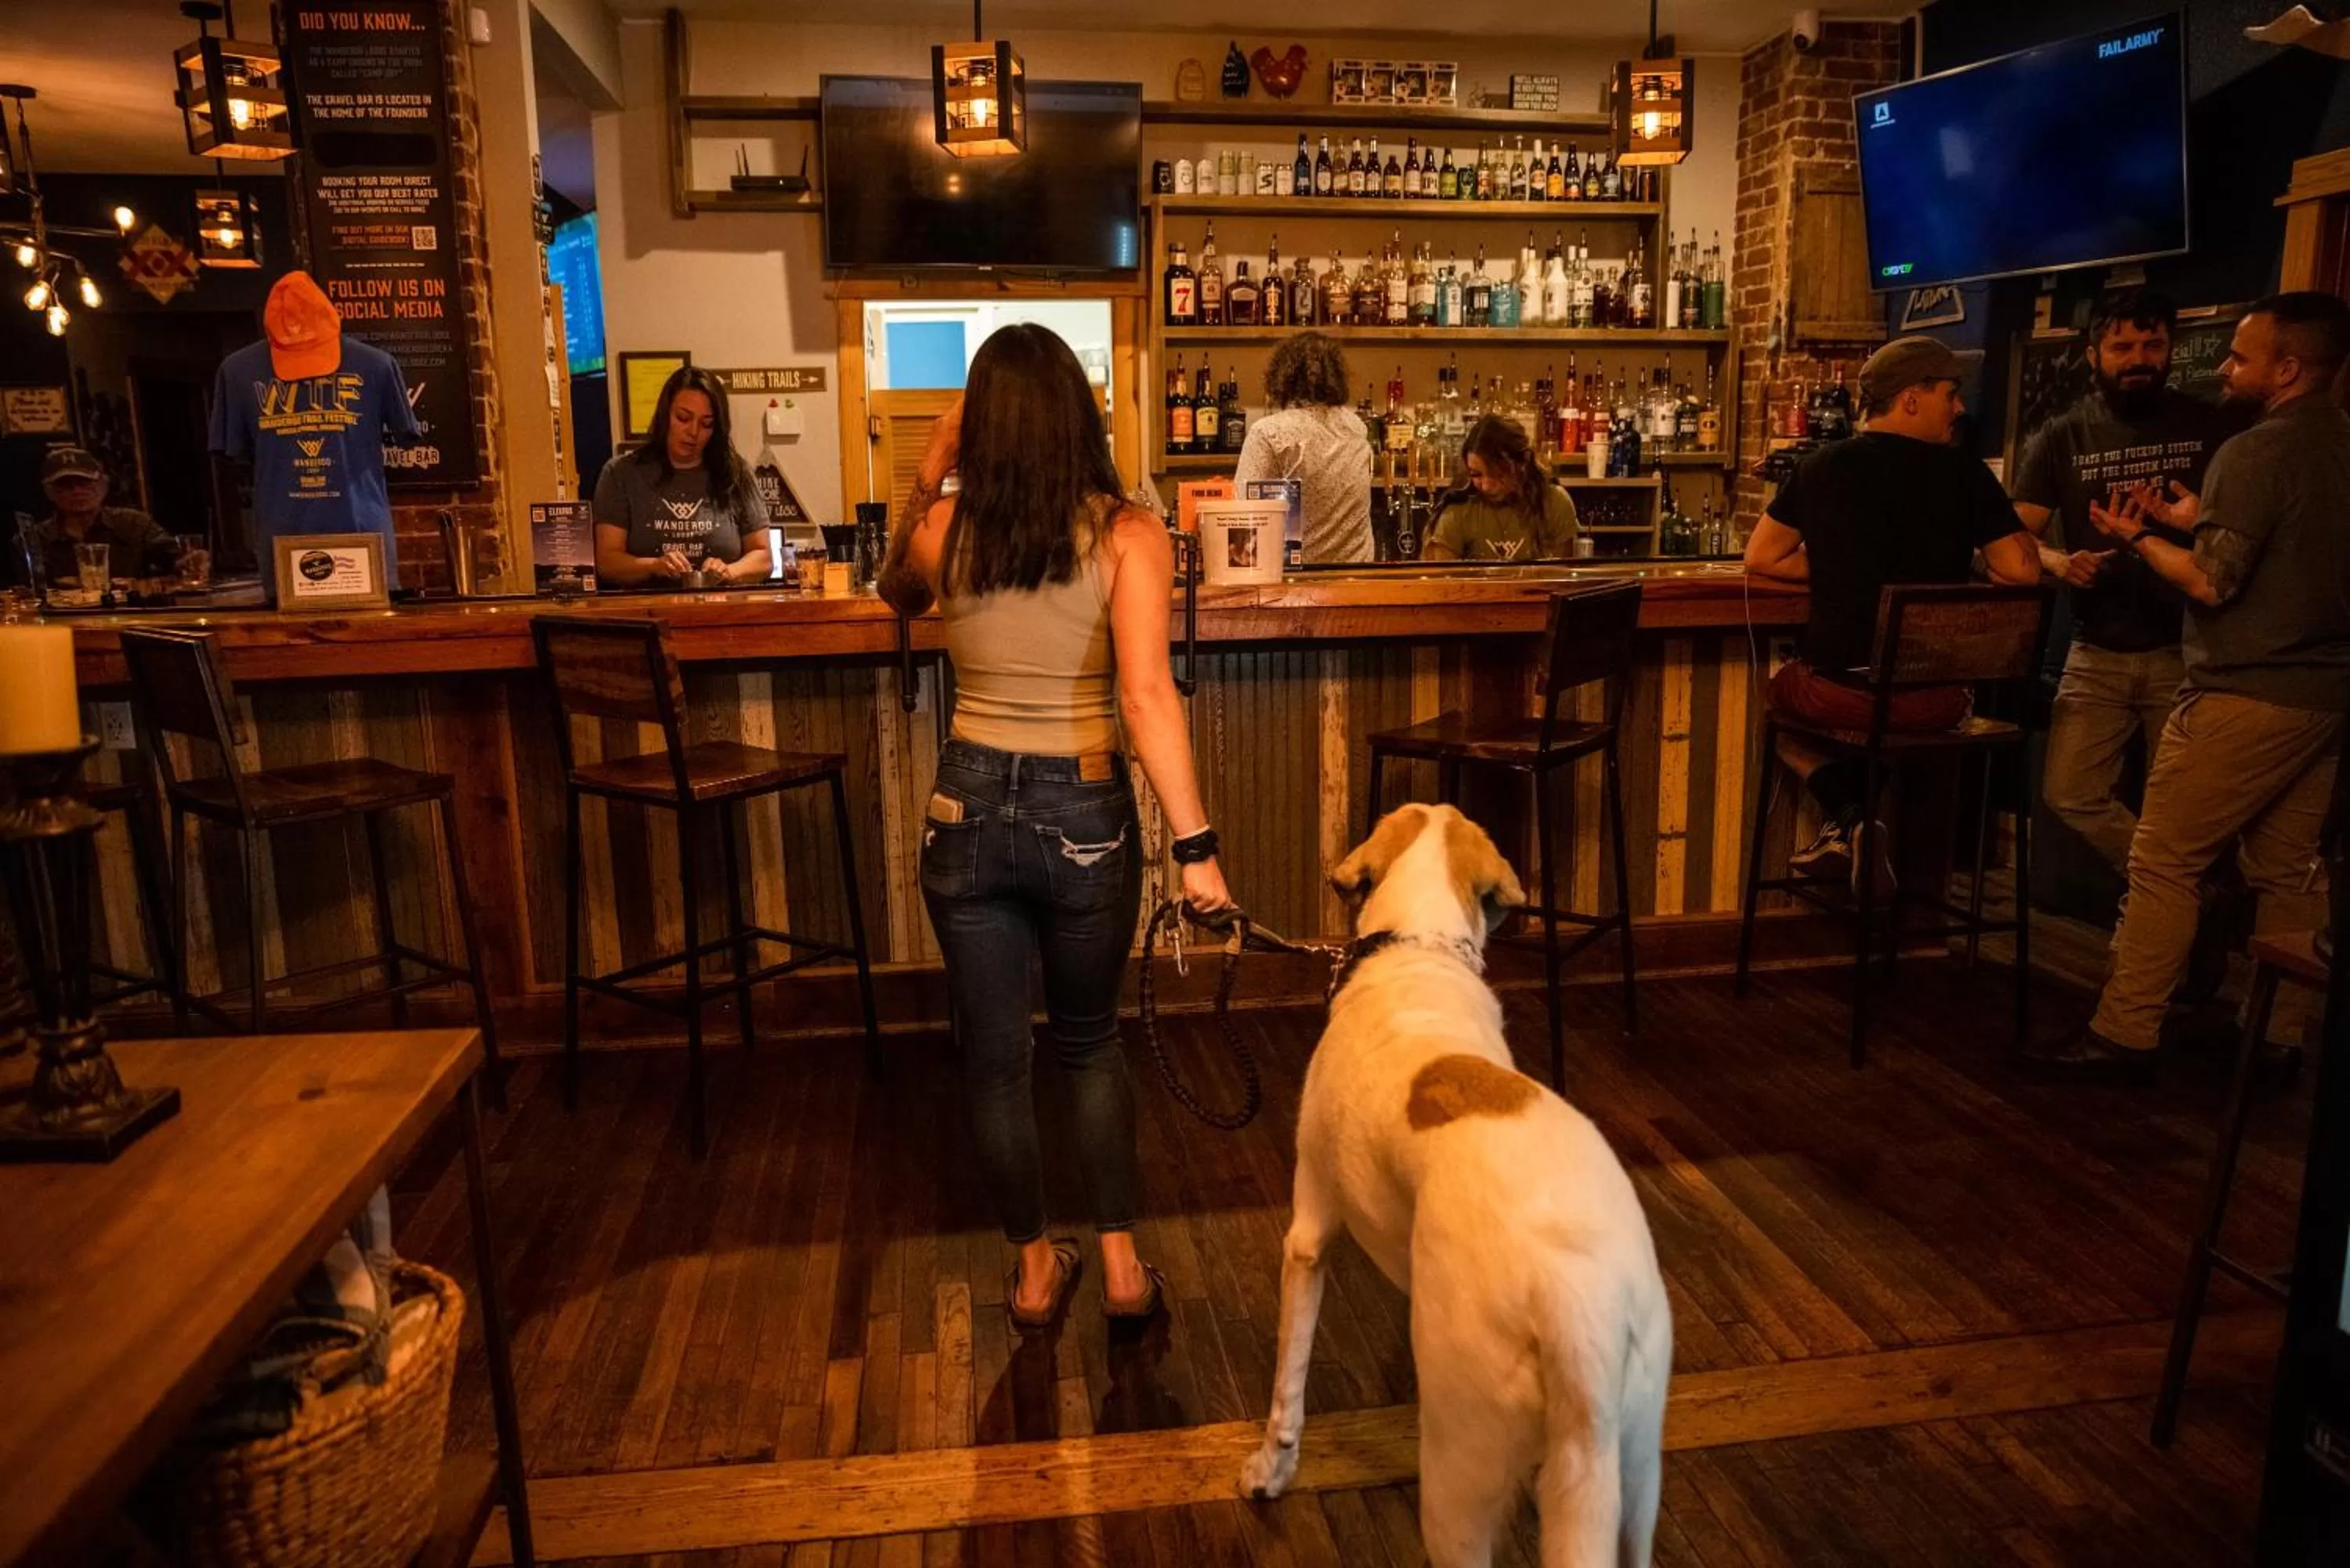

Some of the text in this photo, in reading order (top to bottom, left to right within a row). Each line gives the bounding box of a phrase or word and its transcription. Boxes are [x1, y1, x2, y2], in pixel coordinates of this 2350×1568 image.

[299, 13, 426, 31] DID YOU KNOW...
[2099, 30, 2160, 59] FAILARMY
[358, 176, 378, 186] YOUR
[403, 175, 432, 186] DIRECT
[317, 189, 338, 199] WILL
[329, 279, 445, 298] FOLLOW US ON
[1176, 287, 1191, 313] 7
[336, 301, 444, 320] SOCIAL MEDIA
[732, 370, 801, 389] HIKING TRAILS
[417, 450, 437, 463] BAR
[2104, 450, 2122, 461] THE
[2081, 468, 2099, 482] BUT
[2102, 464, 2120, 479] THE
[2124, 461, 2159, 475] SYSTEM
[654, 518, 713, 530] WANDEROO
